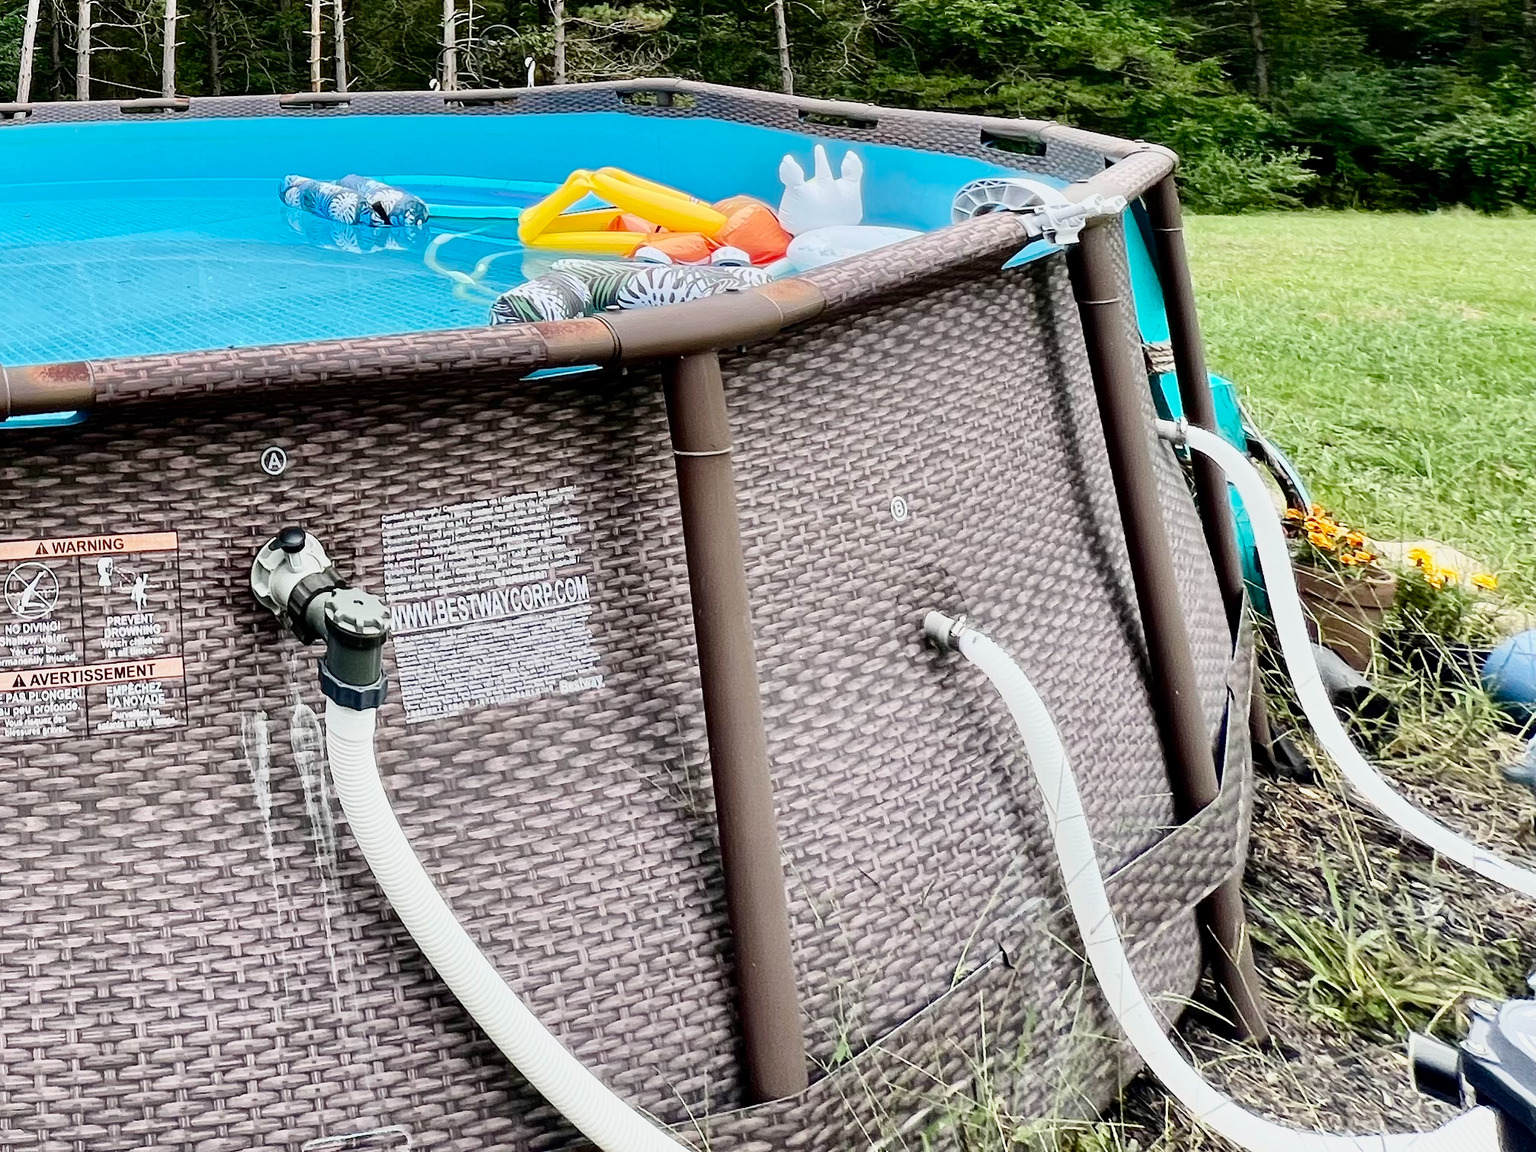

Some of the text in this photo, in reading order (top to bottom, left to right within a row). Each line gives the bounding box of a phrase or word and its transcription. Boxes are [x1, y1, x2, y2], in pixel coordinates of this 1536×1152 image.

[52, 538, 124, 554] WARNING
[391, 574, 590, 631] WWW.BESTWAYCORP.COM
[107, 613, 154, 626] PREVENT
[5, 624, 21, 635] NO
[104, 624, 161, 638] DROWNING
[0, 635, 37, 647] Shallow
[101, 638, 127, 649] Watch
[30, 663, 156, 687] AVERTISSEMENT
[106, 681, 162, 697] EMPÊCHEZ
[6, 691, 25, 704] PAS
[107, 694, 165, 709] LA NOYADE
